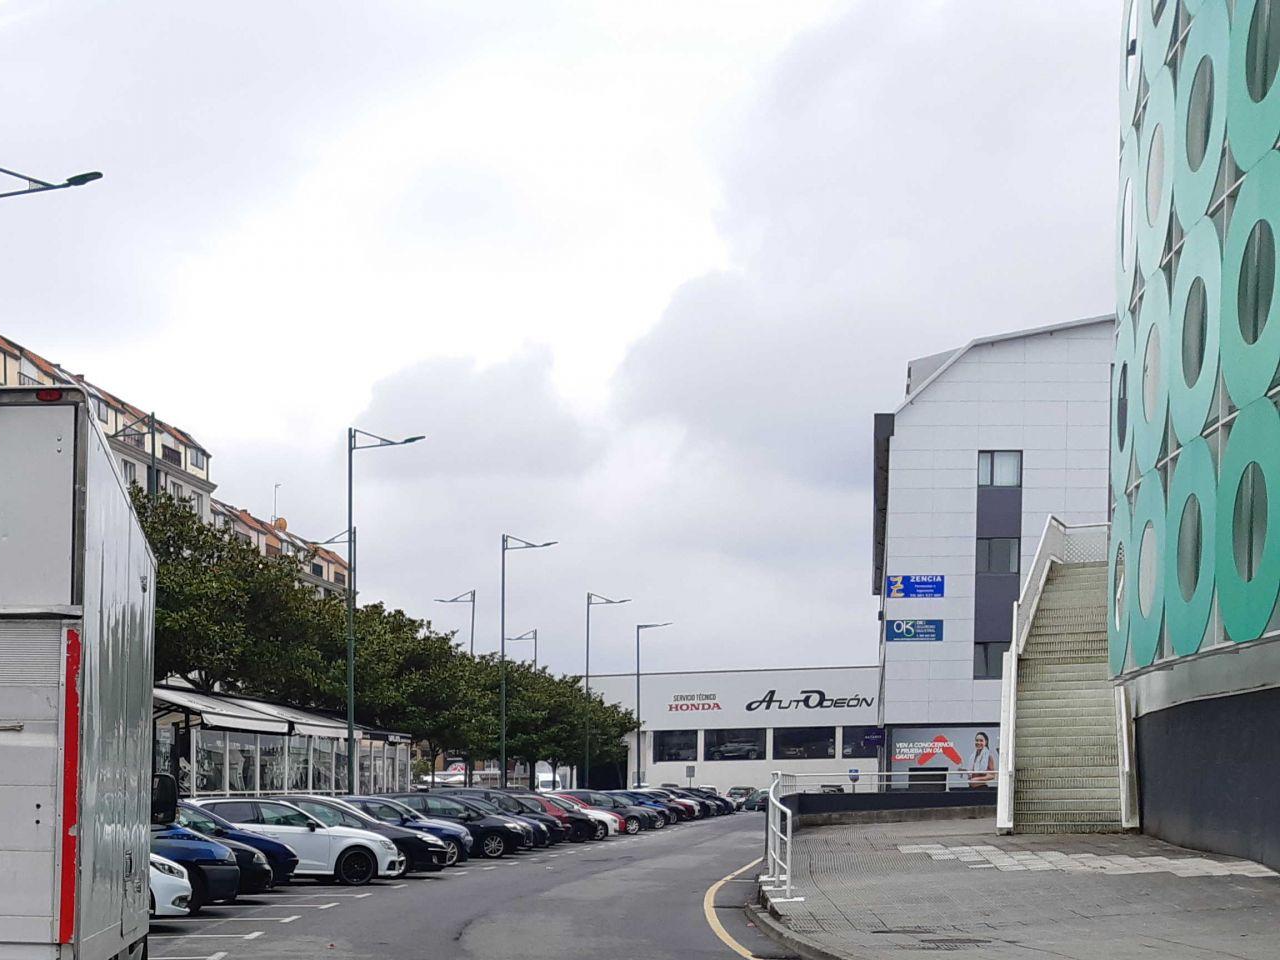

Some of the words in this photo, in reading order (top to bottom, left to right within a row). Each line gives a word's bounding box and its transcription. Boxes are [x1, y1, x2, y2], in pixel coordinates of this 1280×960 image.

[673, 694, 696, 702] SERVICIO
[696, 692, 717, 701] TÉCNICO
[668, 703, 722, 712] HONDA
